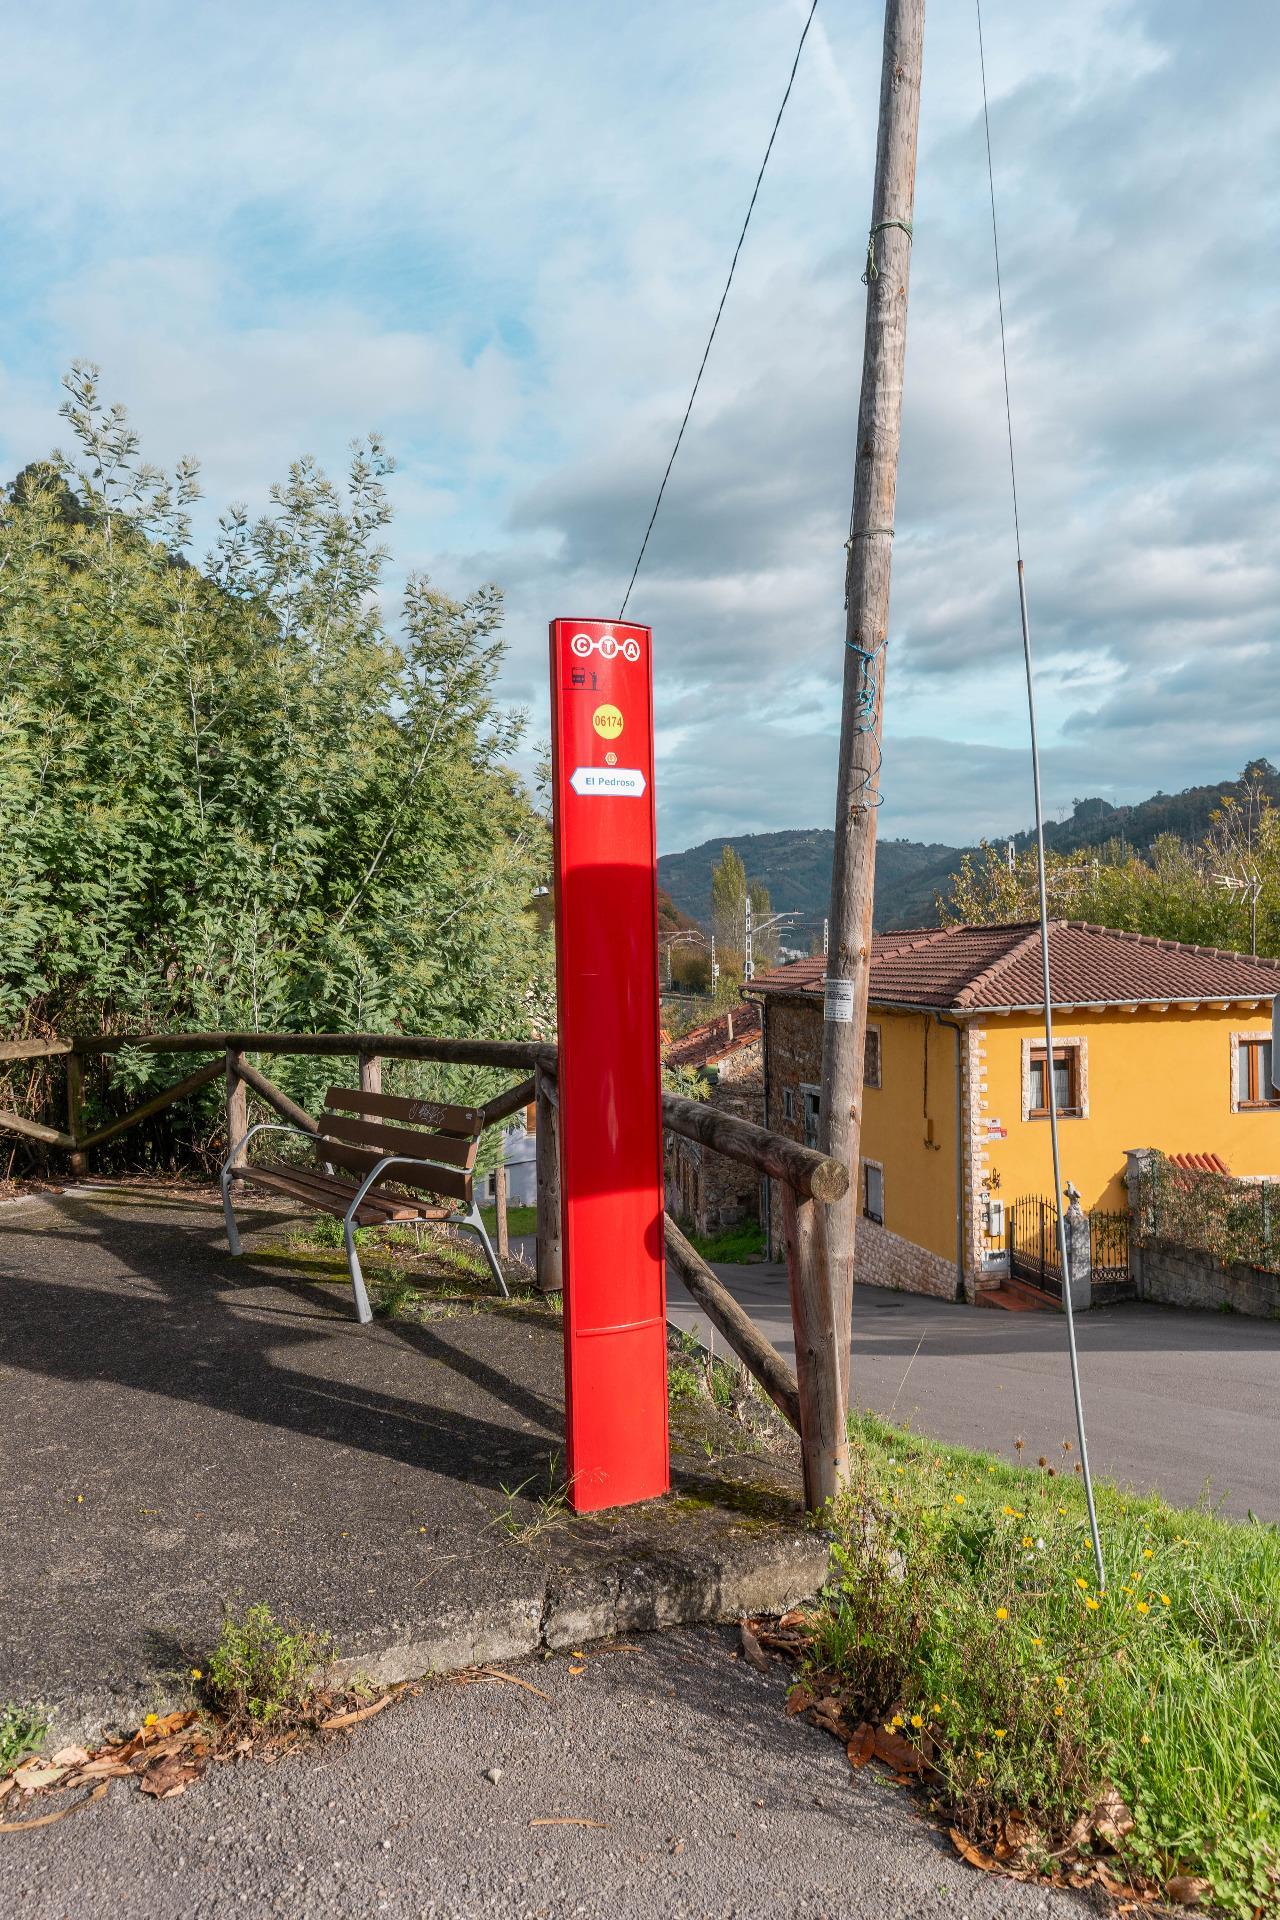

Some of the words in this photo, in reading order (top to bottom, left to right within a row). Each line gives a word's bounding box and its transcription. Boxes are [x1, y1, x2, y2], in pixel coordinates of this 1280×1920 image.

[595, 715, 622, 727] 06174
[585, 777, 595, 785] El
[598, 777, 635, 787] Pedroso
